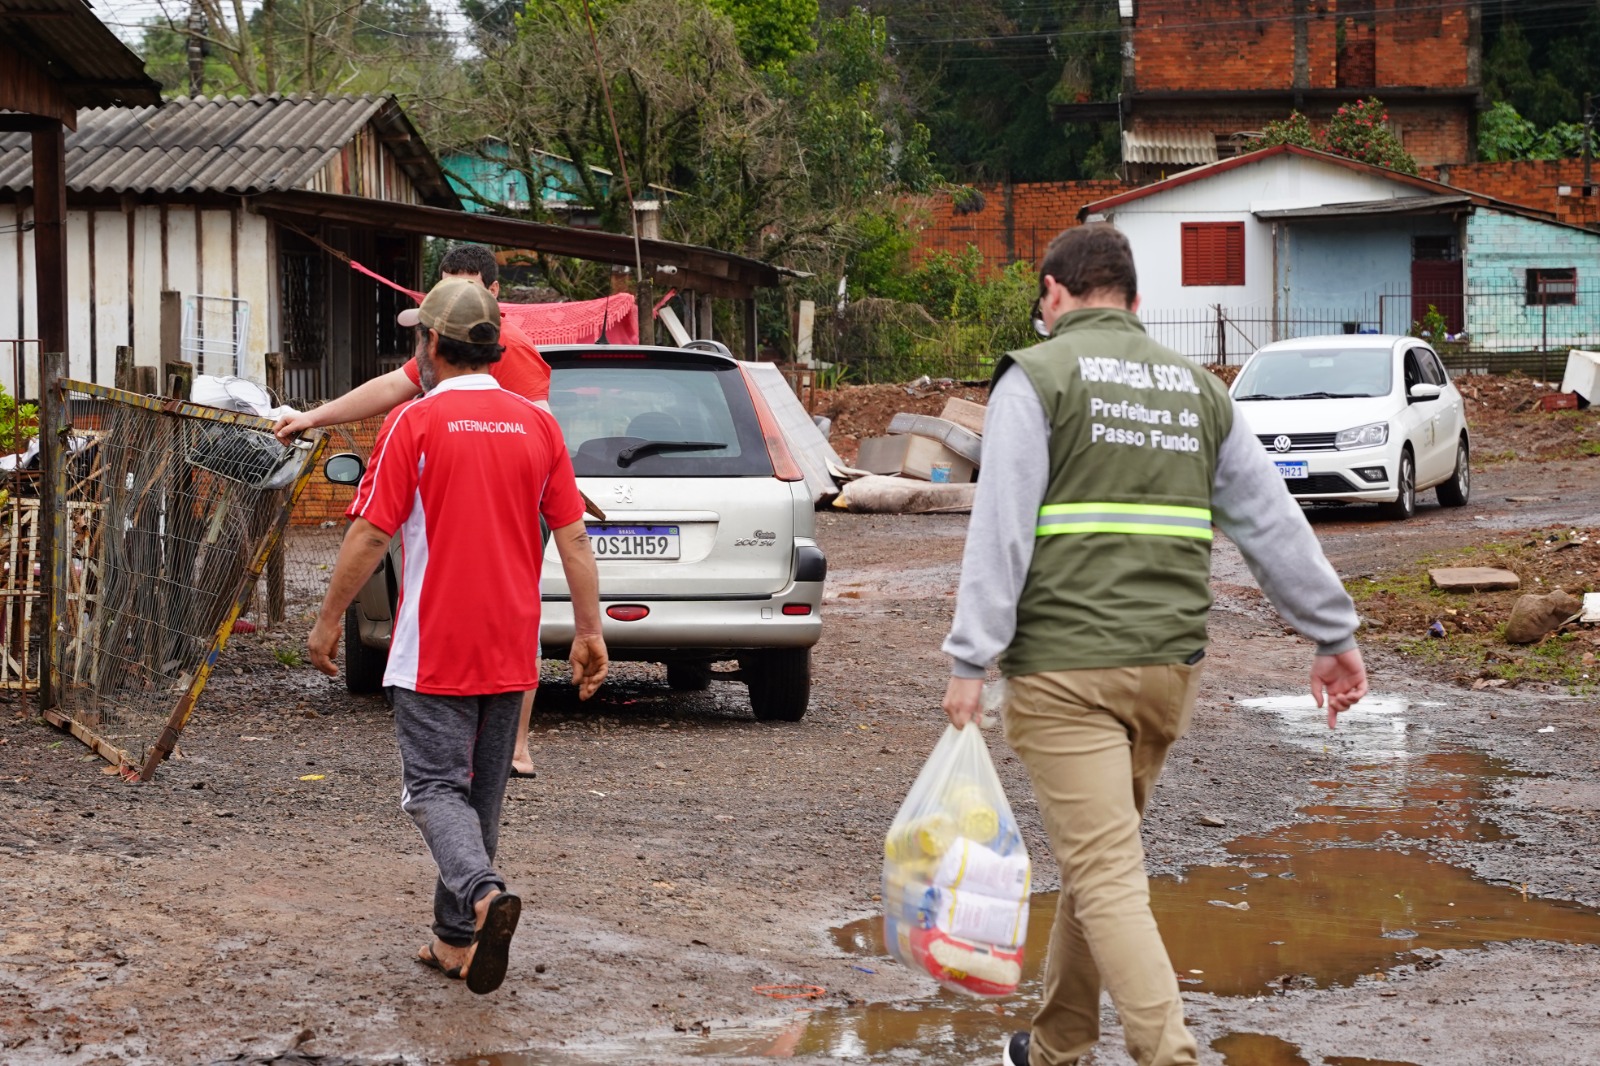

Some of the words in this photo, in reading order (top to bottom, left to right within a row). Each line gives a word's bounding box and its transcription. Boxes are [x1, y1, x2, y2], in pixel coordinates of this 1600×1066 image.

[1153, 364, 1200, 394] SOCIAL
[1090, 397, 1171, 425] Prefeitura
[1178, 408, 1199, 427] de
[447, 420, 527, 434] INTERNACIONAL
[1091, 423, 1145, 446] Passo
[1151, 430, 1200, 452] Fundo
[1279, 467, 1302, 477] 9H21
